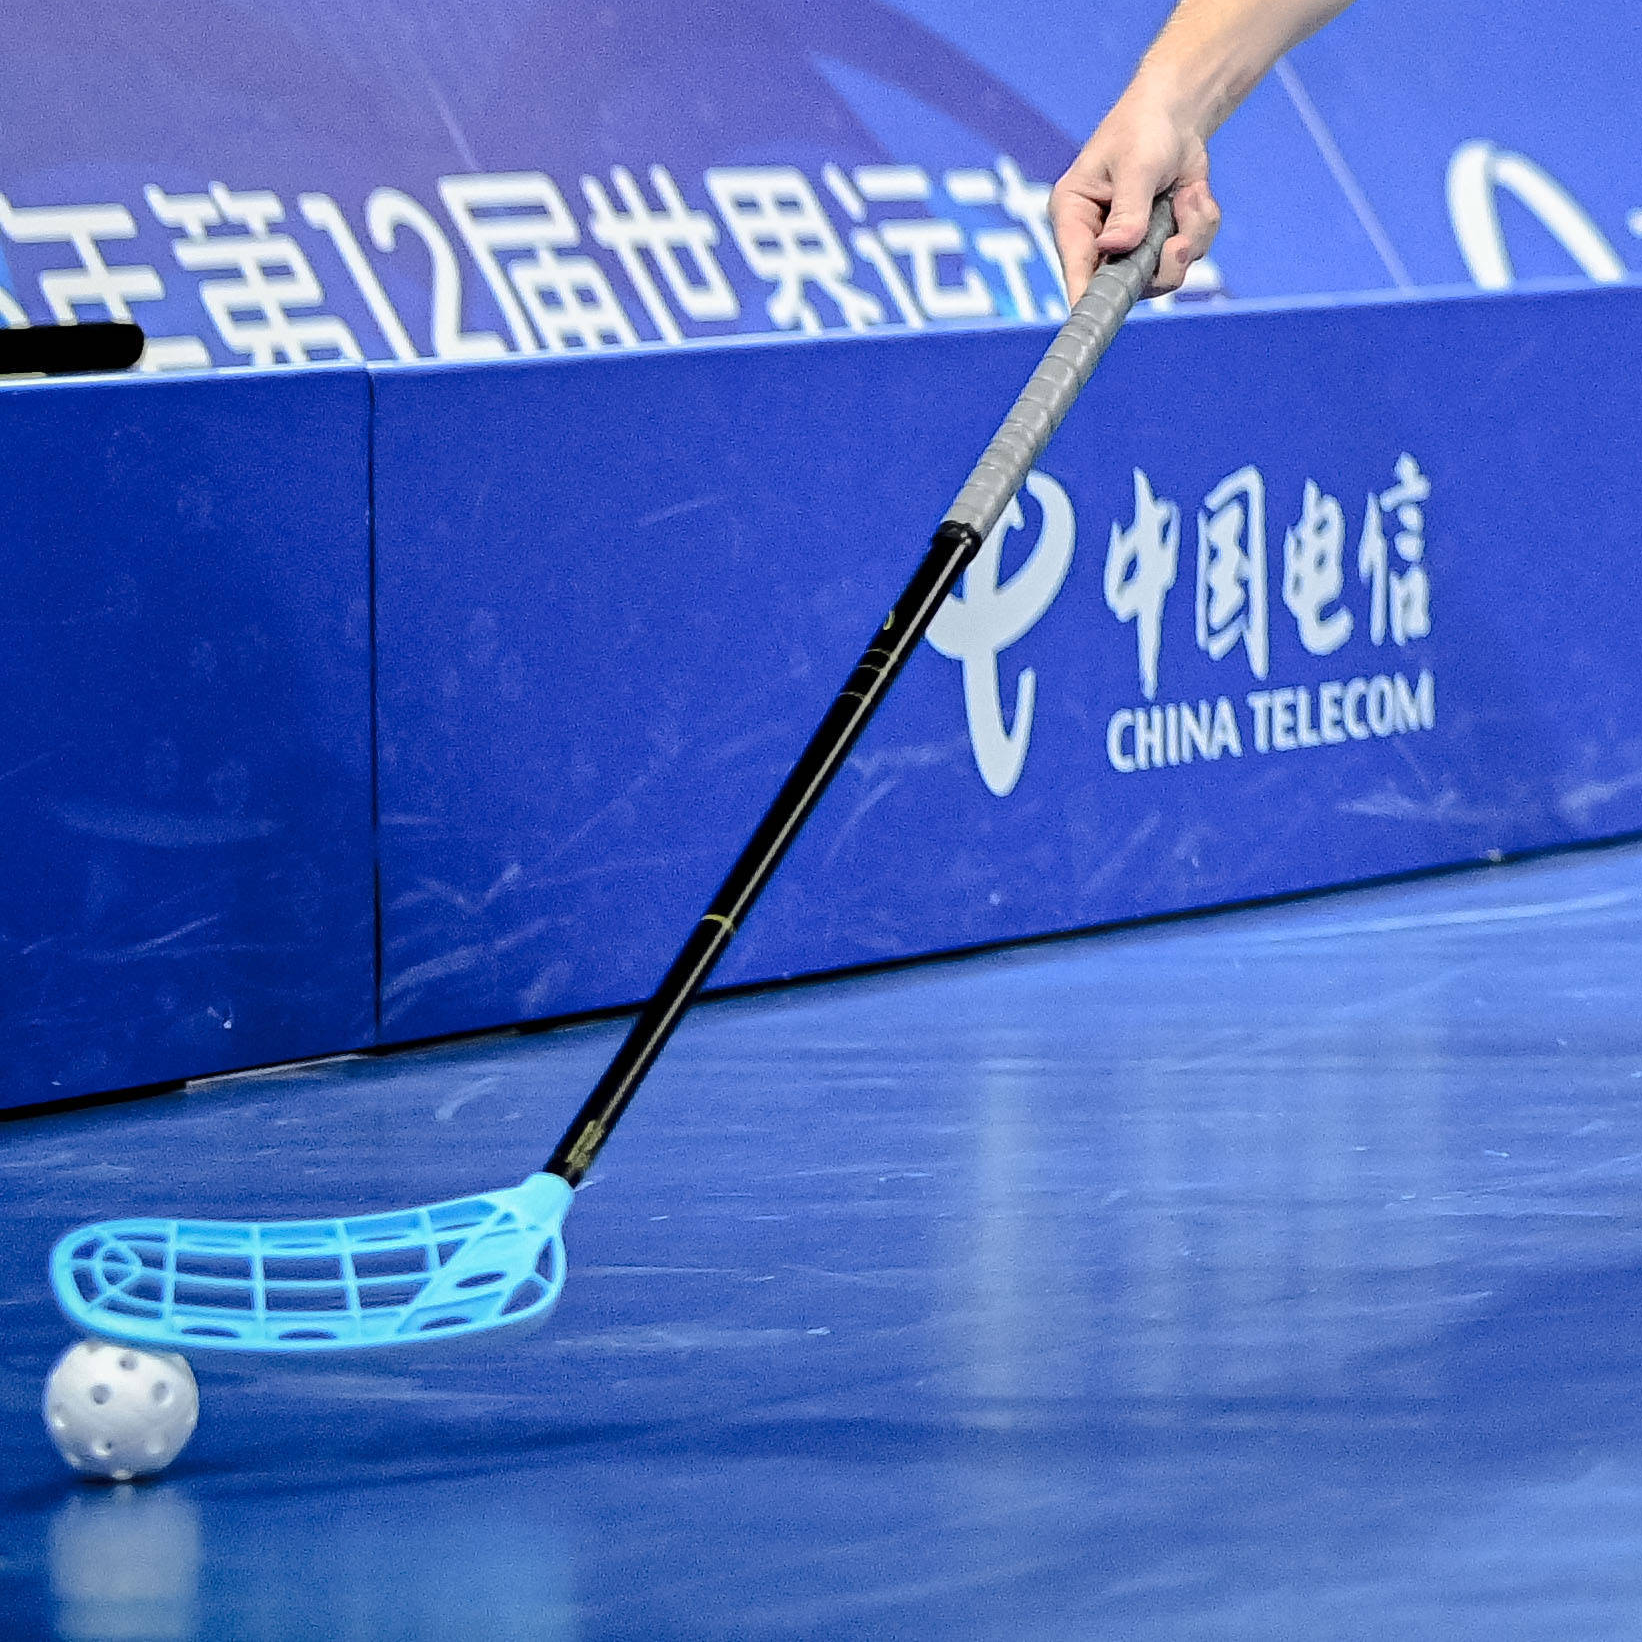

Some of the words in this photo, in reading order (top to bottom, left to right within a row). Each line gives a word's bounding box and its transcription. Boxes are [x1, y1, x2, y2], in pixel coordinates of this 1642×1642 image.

[1103, 451, 1432, 700] 中国电信
[1106, 694, 1243, 773] CHINA
[1246, 667, 1436, 753] TELECOM
